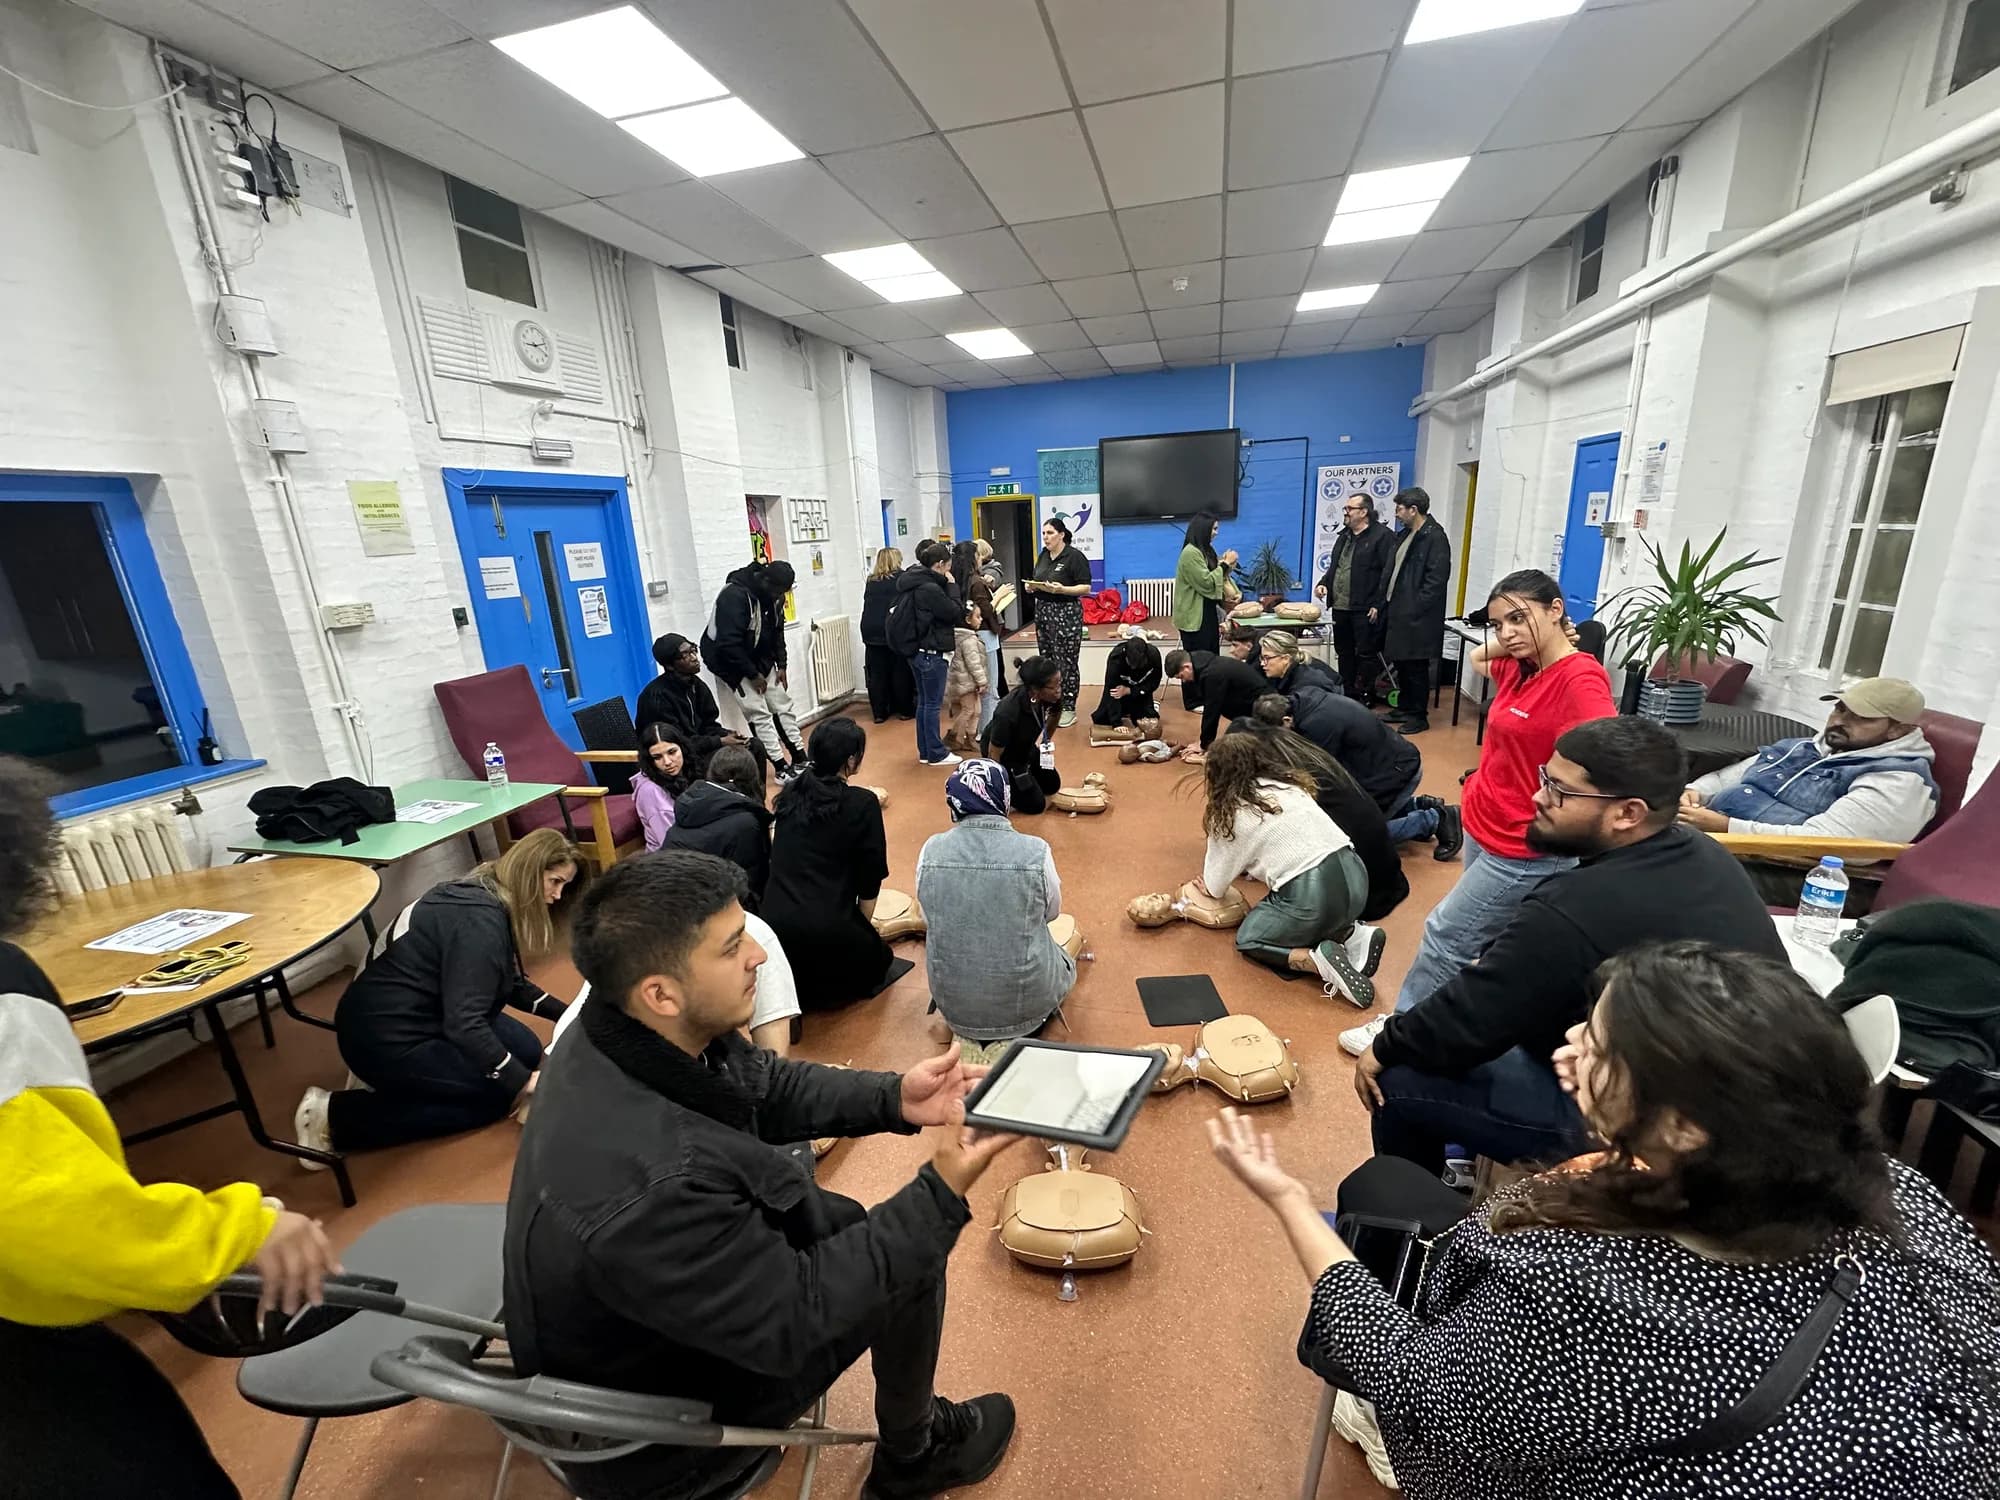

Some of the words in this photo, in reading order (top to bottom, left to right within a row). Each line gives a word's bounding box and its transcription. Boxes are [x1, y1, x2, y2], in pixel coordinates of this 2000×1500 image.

[1043, 460, 1097, 471] EDMONTON
[1325, 469, 1345, 477] OUR
[1347, 466, 1393, 476] PARTNERS
